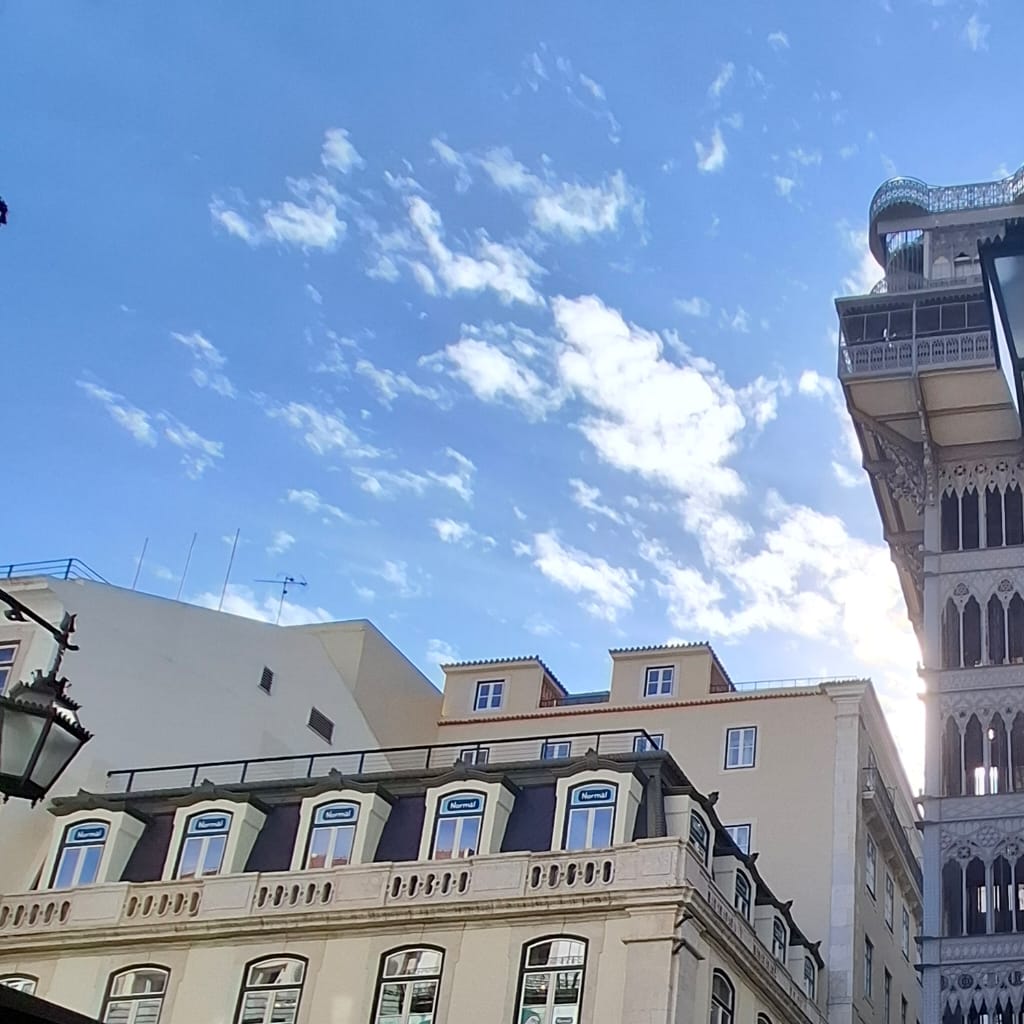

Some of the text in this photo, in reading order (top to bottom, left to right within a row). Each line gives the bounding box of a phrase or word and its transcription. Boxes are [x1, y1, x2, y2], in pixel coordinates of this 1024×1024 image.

[581, 791, 608, 800] Normal
[450, 801, 477, 809] Normal
[325, 809, 351, 818] Normal
[199, 819, 224, 828] Normal
[77, 830, 102, 839] Normal
